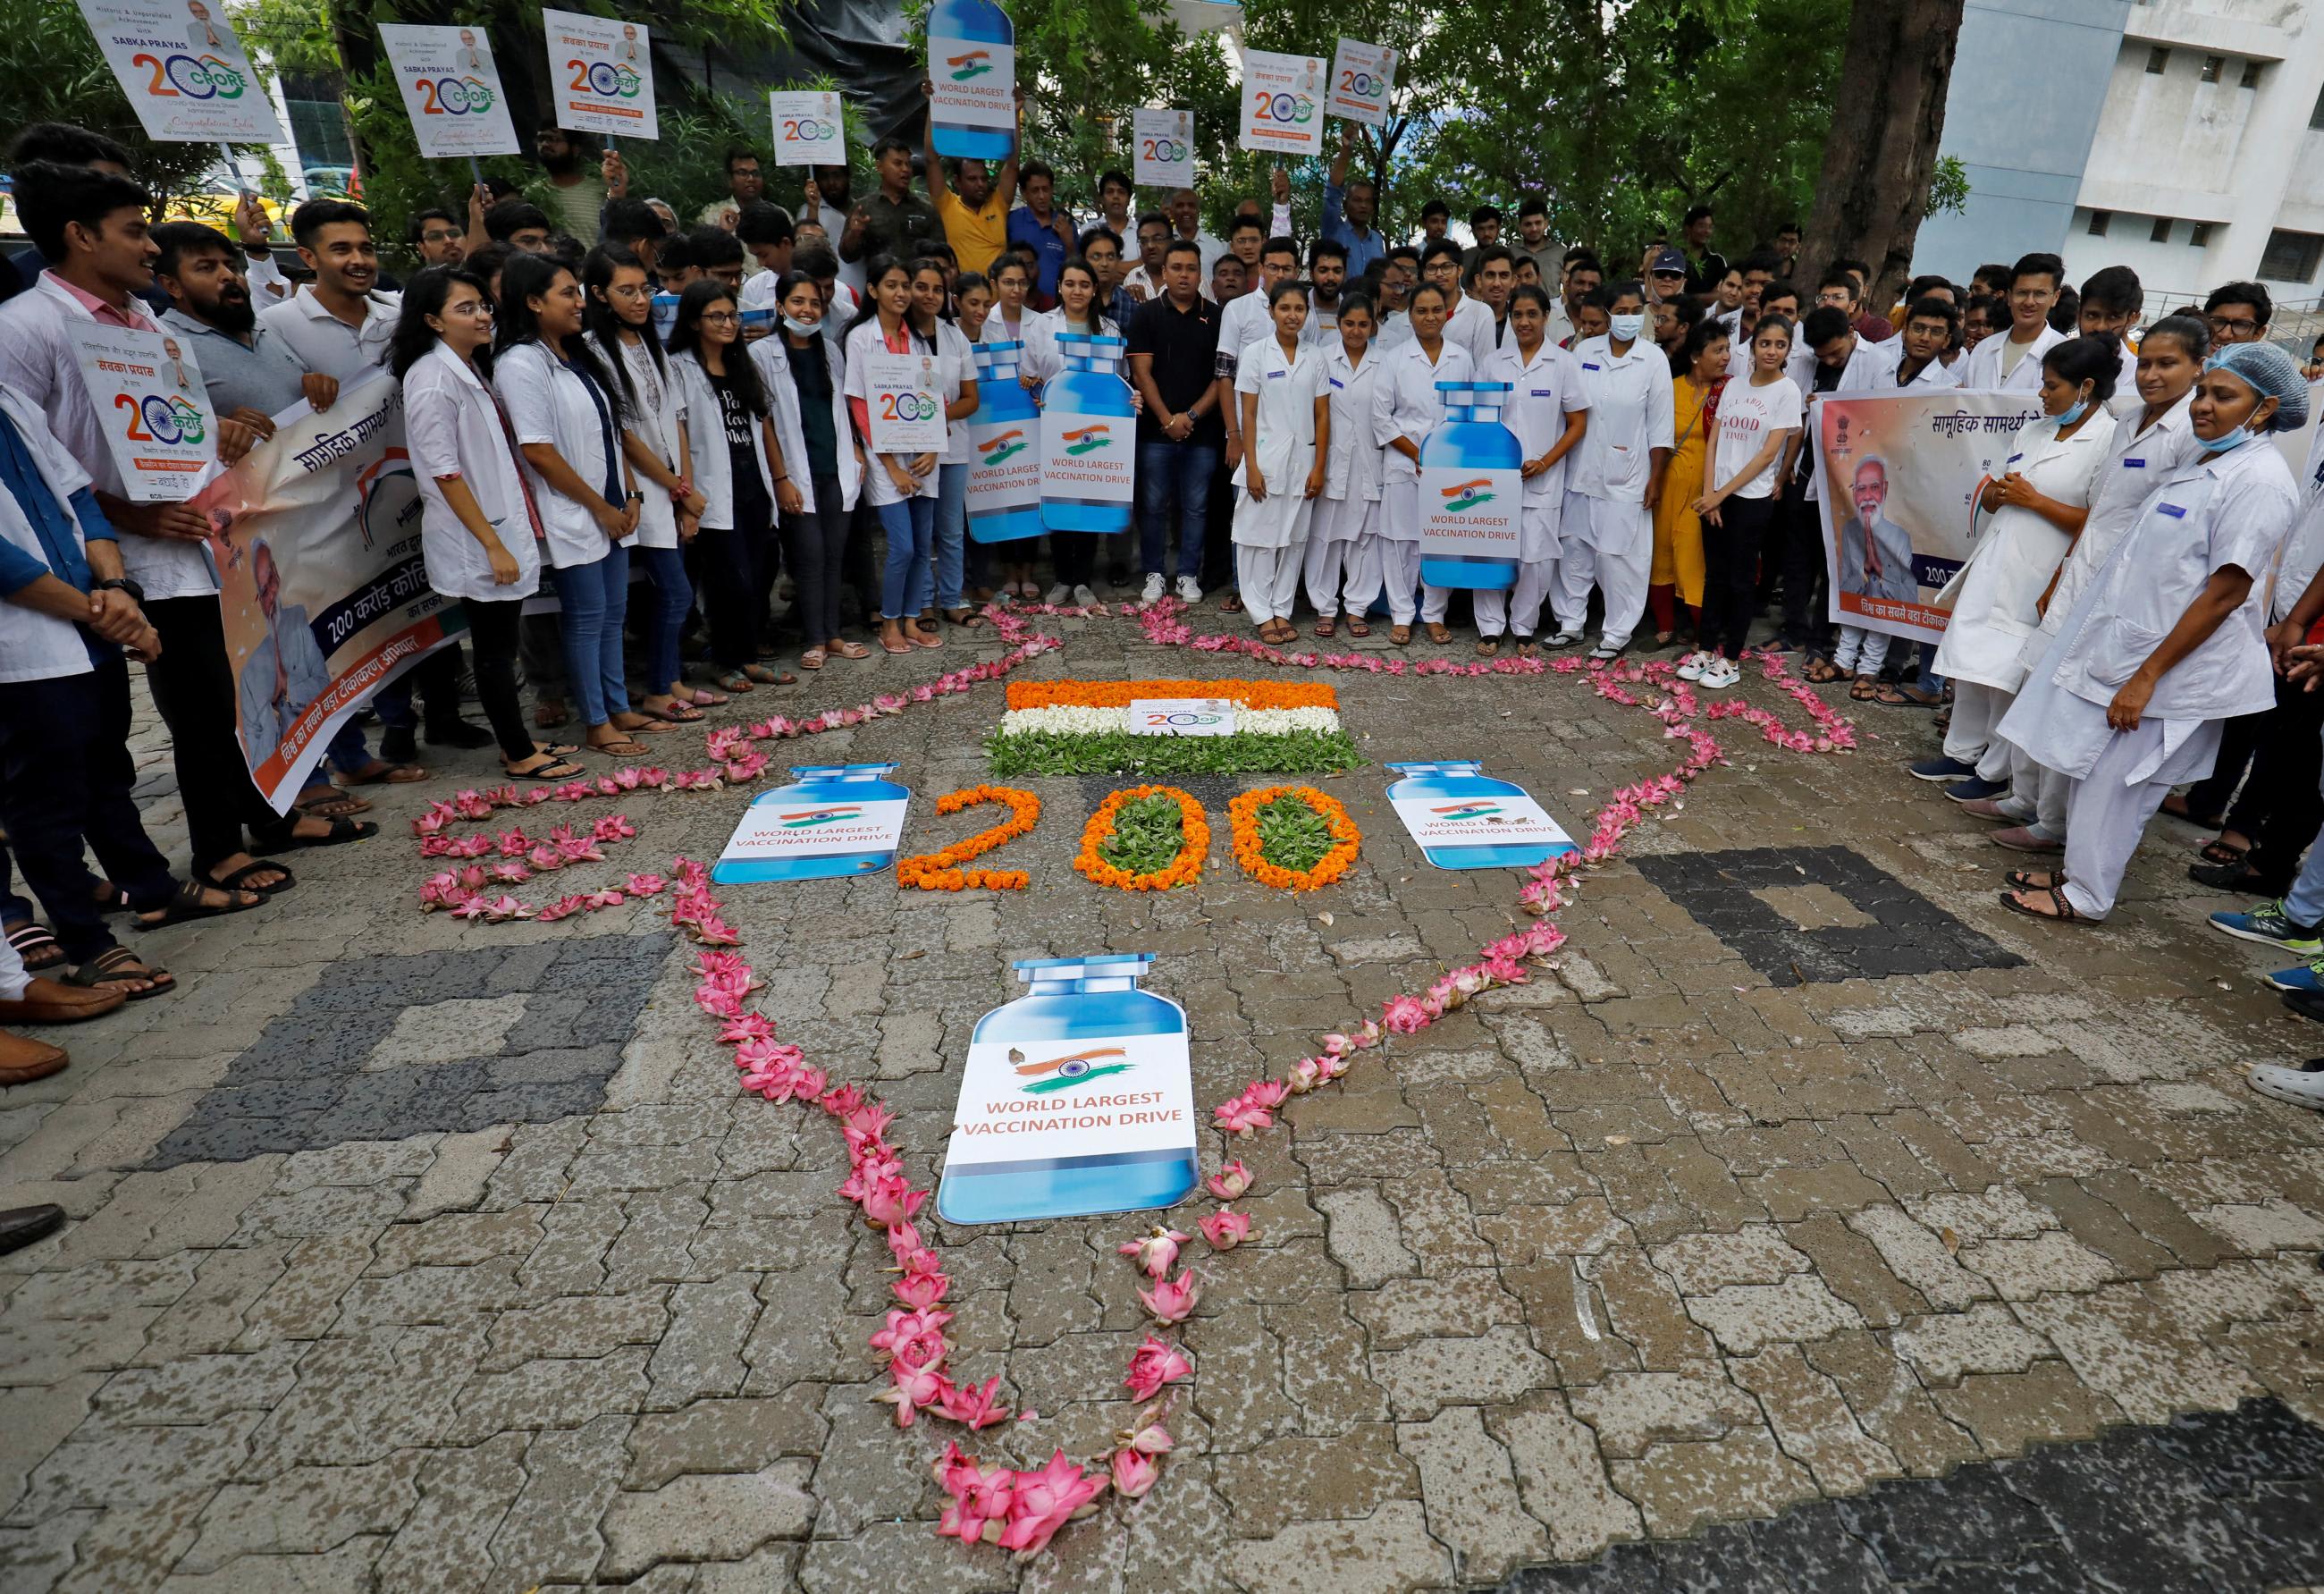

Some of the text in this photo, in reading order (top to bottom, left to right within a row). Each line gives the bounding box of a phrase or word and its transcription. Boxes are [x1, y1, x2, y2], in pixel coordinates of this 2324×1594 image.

[112, 36, 189, 50] SABKA PRAYAS
[403, 65, 427, 73] SABKA
[189, 72, 248, 88] CRORE
[453, 91, 496, 102] CRORE
[939, 83, 1005, 97] WORLD LARGEST
[933, 96, 1012, 111] VACCINATION DRIVE
[808, 127, 838, 135] CRORE
[96, 359, 156, 377] सबका प्रयास
[907, 403, 938, 412] CRORE
[1743, 397, 1768, 416] ABOUT
[1721, 415, 1760, 431] GOOD
[1932, 409, 1982, 439] सामूहिक
[1983, 409, 2027, 434] सामर्थ्य
[1725, 431, 1748, 443] TIMES
[1051, 458, 1124, 470] WORLD LARGEST
[1982, 459, 1991, 467] 80
[972, 468, 1006, 480] WORLD
[1044, 470, 1131, 485] VACCINATION DRIVE
[966, 478, 1025, 494] VACCINATION
[1430, 515, 1510, 527] WORLD LARGEST
[1423, 528, 1517, 541] VACCINATION DRIVE
[386, 540, 408, 559] भारत
[1925, 566, 1947, 585] 200
[327, 610, 354, 645] 200
[354, 585, 391, 620] करोड़
[406, 603, 422, 619] का
[1860, 598, 1874, 615] विश्व
[1874, 604, 1887, 616] का
[1887, 605, 1907, 620] सबसे
[1907, 609, 1922, 626] बड़ा
[281, 635, 420, 765] विश्व का सबसे बड़ा टीकाकरण अभियान
[753, 825, 883, 838] WORLD LARGEST
[1419, 827, 1511, 837] VACCINATION
[736, 833, 893, 847] VACCINATION DRIVE
[986, 1092, 1165, 1115] WORLD LARGEST
[964, 1109, 1183, 1136] VACCINATION DRIVE
